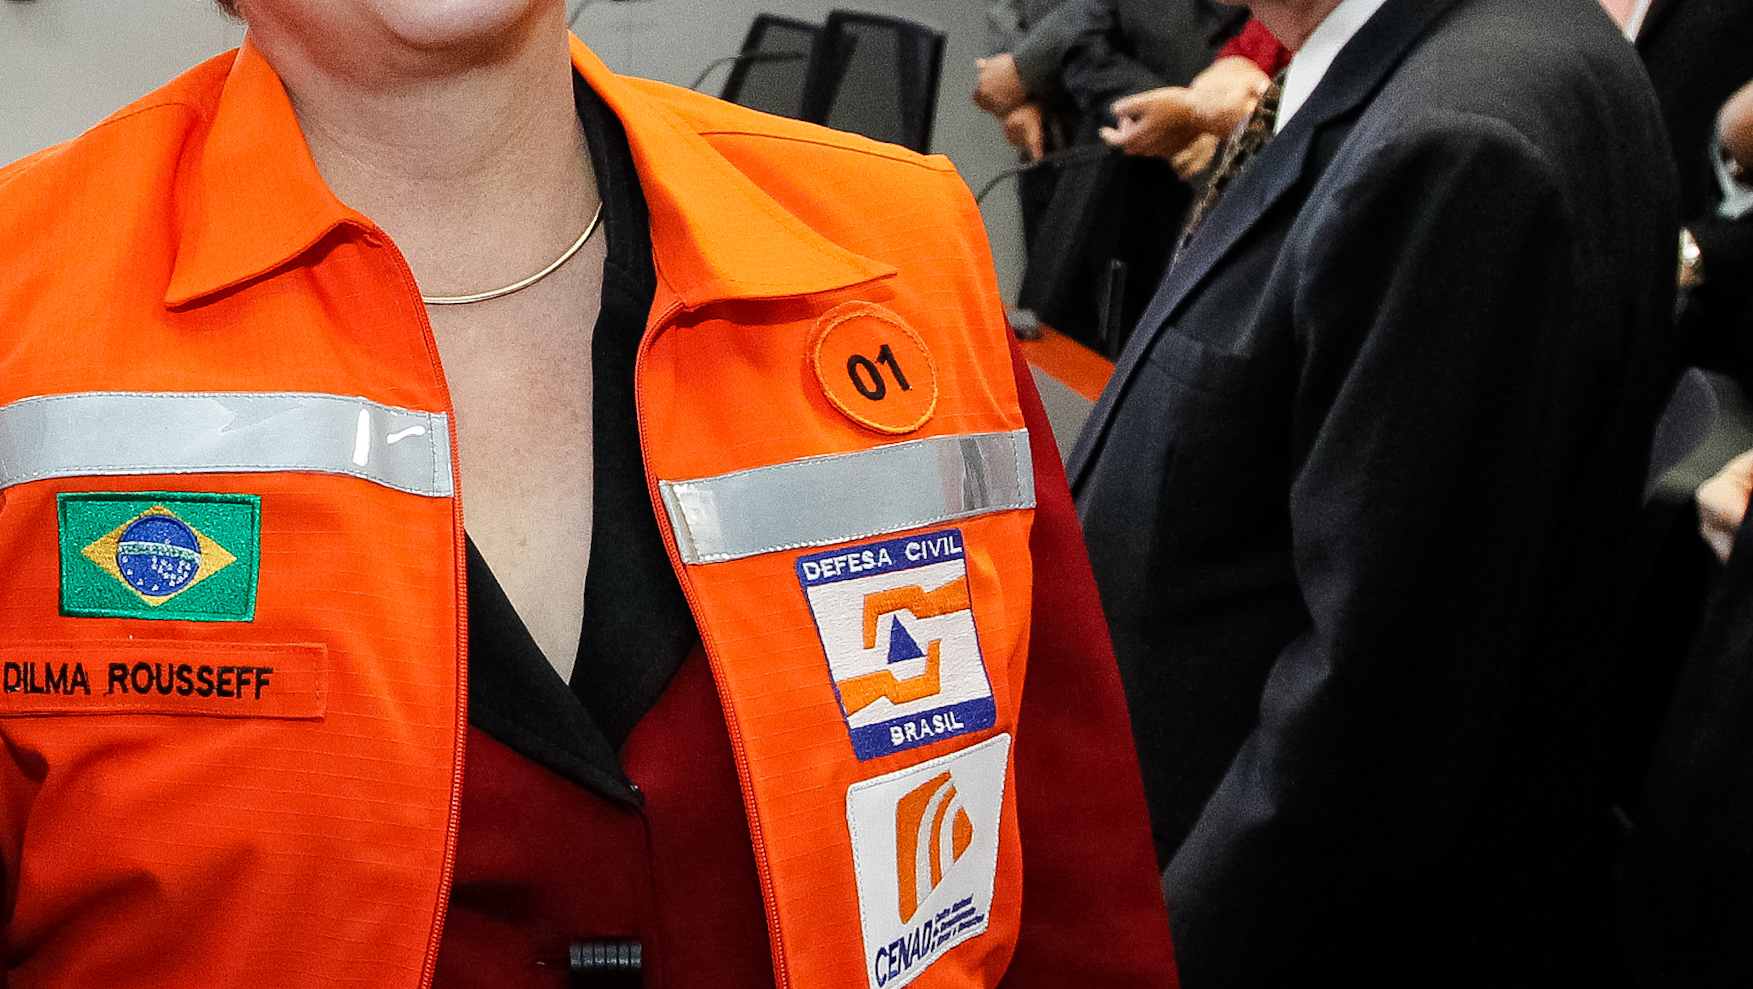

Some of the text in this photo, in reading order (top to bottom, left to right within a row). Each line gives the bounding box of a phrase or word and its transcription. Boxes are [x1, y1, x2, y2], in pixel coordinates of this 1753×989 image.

[847, 344, 912, 401] 01
[802, 536, 963, 581] DEFESA CIVIL
[3, 662, 274, 699] DILMA ROUSSEFF
[889, 712, 965, 747] BRASIL
[875, 919, 933, 988] CENAD
